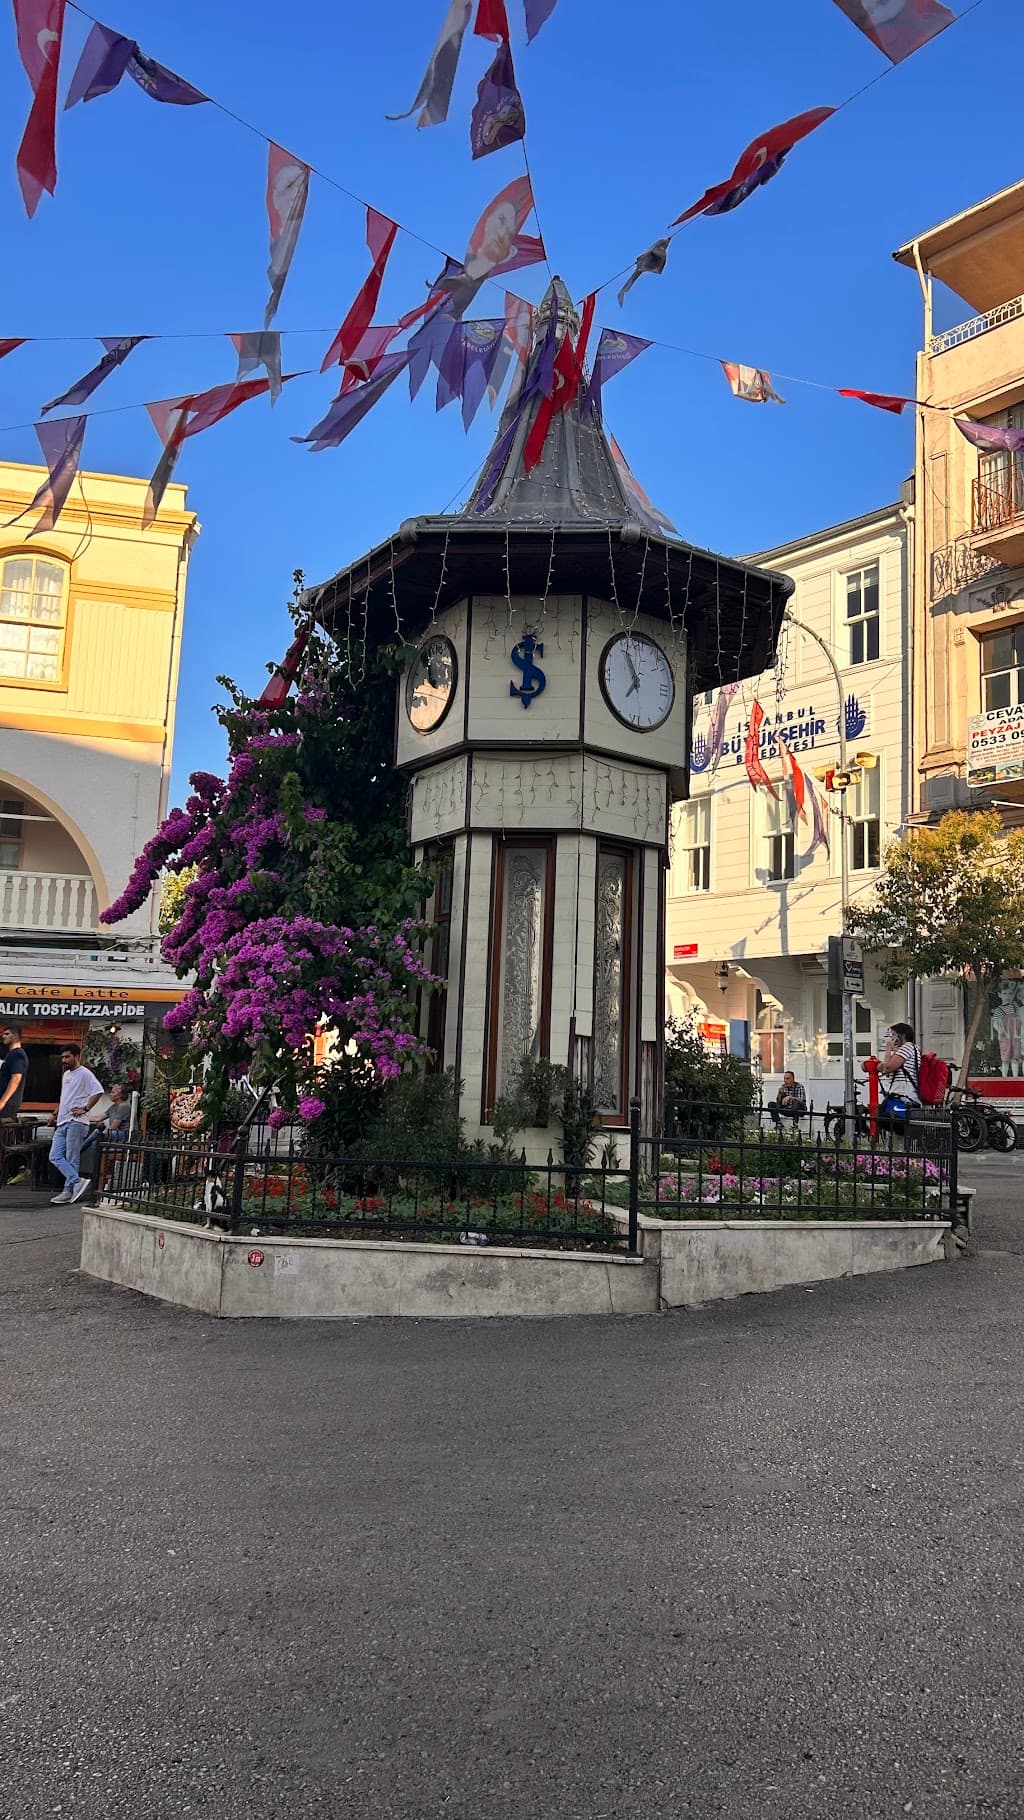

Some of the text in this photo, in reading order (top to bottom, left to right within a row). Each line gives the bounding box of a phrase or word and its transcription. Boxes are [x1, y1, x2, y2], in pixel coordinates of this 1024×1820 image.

[986, 704, 1024, 721] CEVA
[721, 717, 826, 756] BÜÜKŞEHİR
[972, 722, 1021, 739] PEYZAJ
[971, 734, 1006, 749] 0533
[15, 986, 129, 999] Cafe Latte
[0, 1002, 145, 1017] ALIK TOST-PİZZA-PİDE
